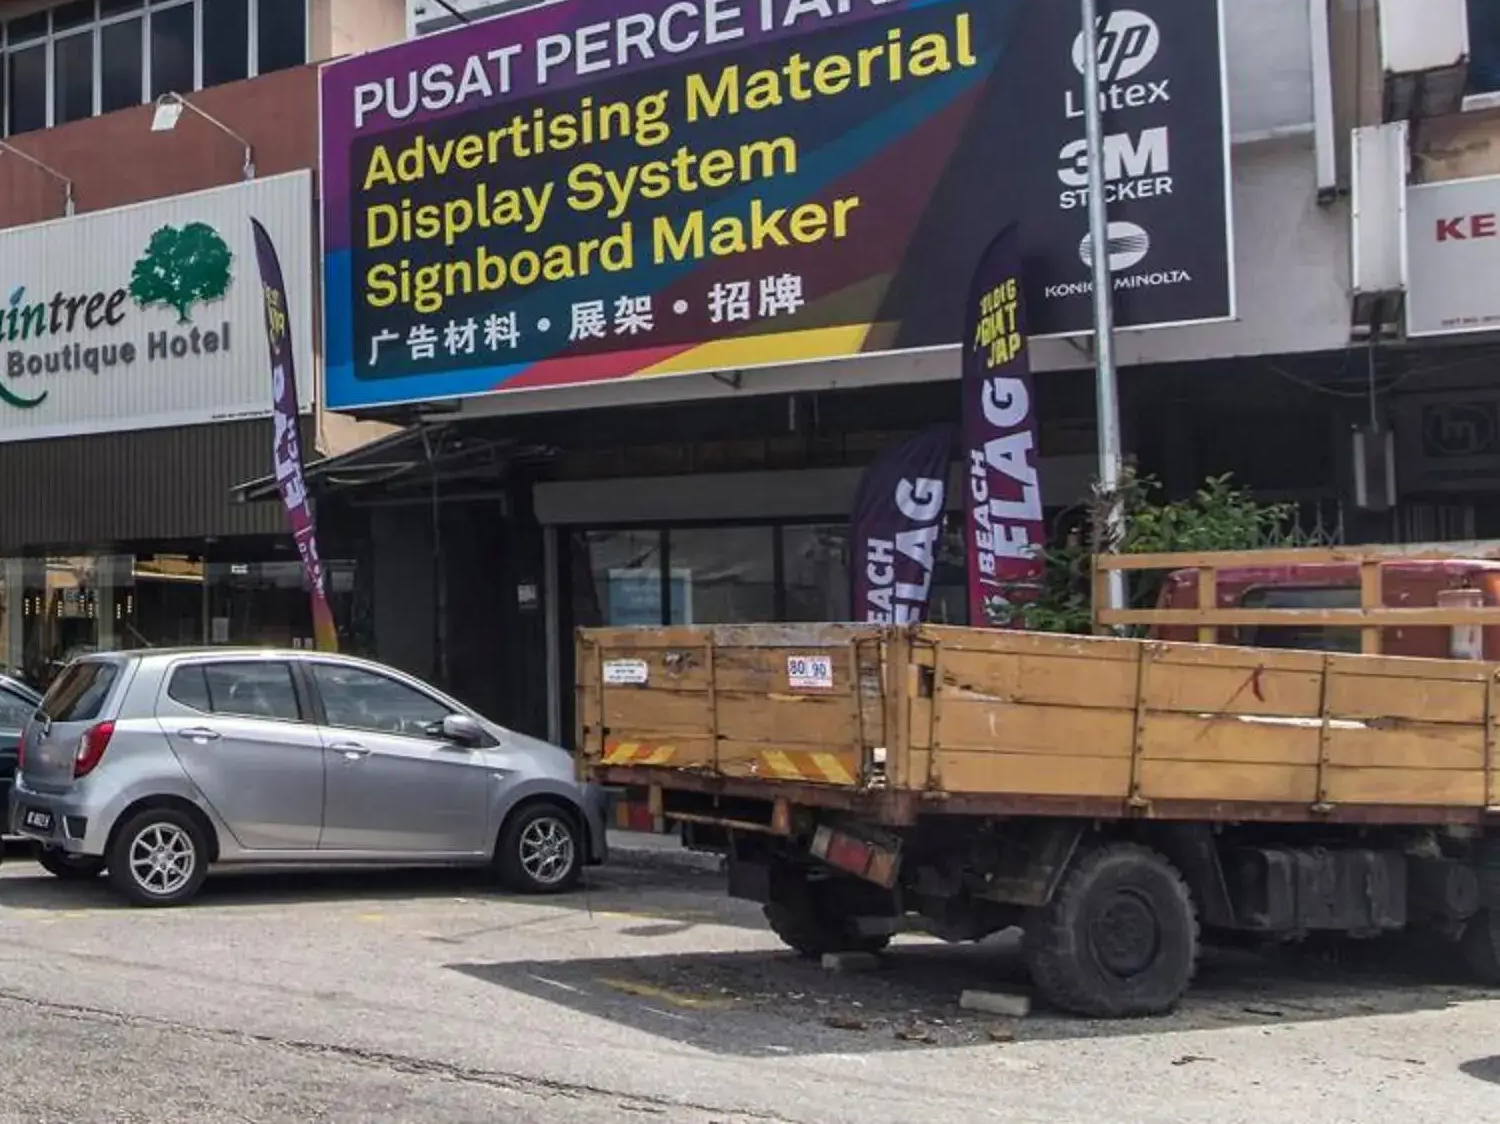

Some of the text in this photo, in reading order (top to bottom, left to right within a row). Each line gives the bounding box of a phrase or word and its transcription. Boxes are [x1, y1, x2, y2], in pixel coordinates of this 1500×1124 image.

[353, 45, 522, 128] PUSAT
[364, 13, 976, 190] Advertising Material
[366, 135, 798, 248] Display System
[1057, 126, 1169, 187] 3M
[1059, 176, 1172, 209] STCKER
[366, 193, 858, 313] Signboard Maker
[1113, 269, 1192, 290] MINOLTA
[7, 322, 231, 377] Boutique Hotel
[368, 273, 804, 365] 广告材料 展架 招牌
[972, 449, 996, 573] BEACH
[981, 377, 1043, 560] FLAG
[866, 538, 895, 624] EACH
[811, 662, 827, 679] 90
